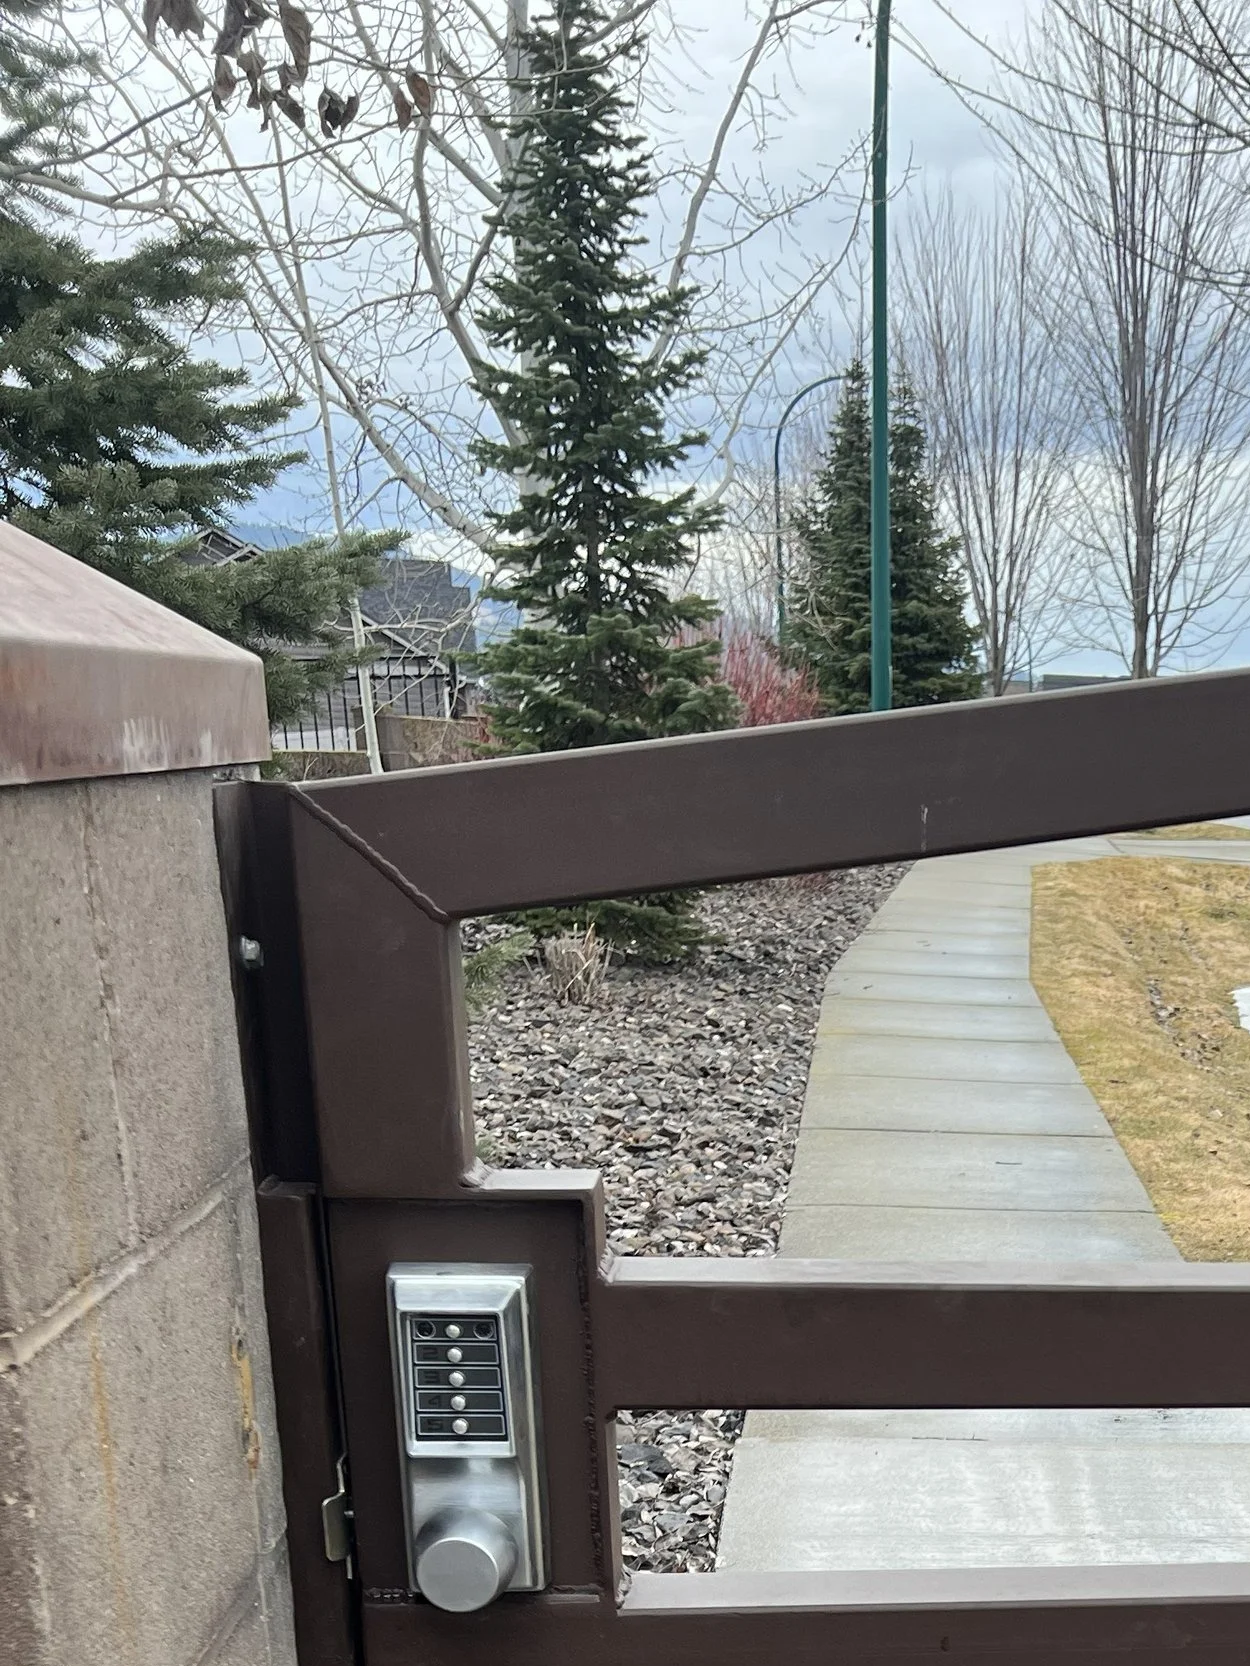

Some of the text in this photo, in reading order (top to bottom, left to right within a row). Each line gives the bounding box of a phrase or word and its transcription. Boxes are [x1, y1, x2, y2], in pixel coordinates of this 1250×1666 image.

[423, 1347, 438, 1359] 2
[425, 1371, 440, 1384] 3
[427, 1395, 441, 1409] 4
[427, 1419, 443, 1432] 5
